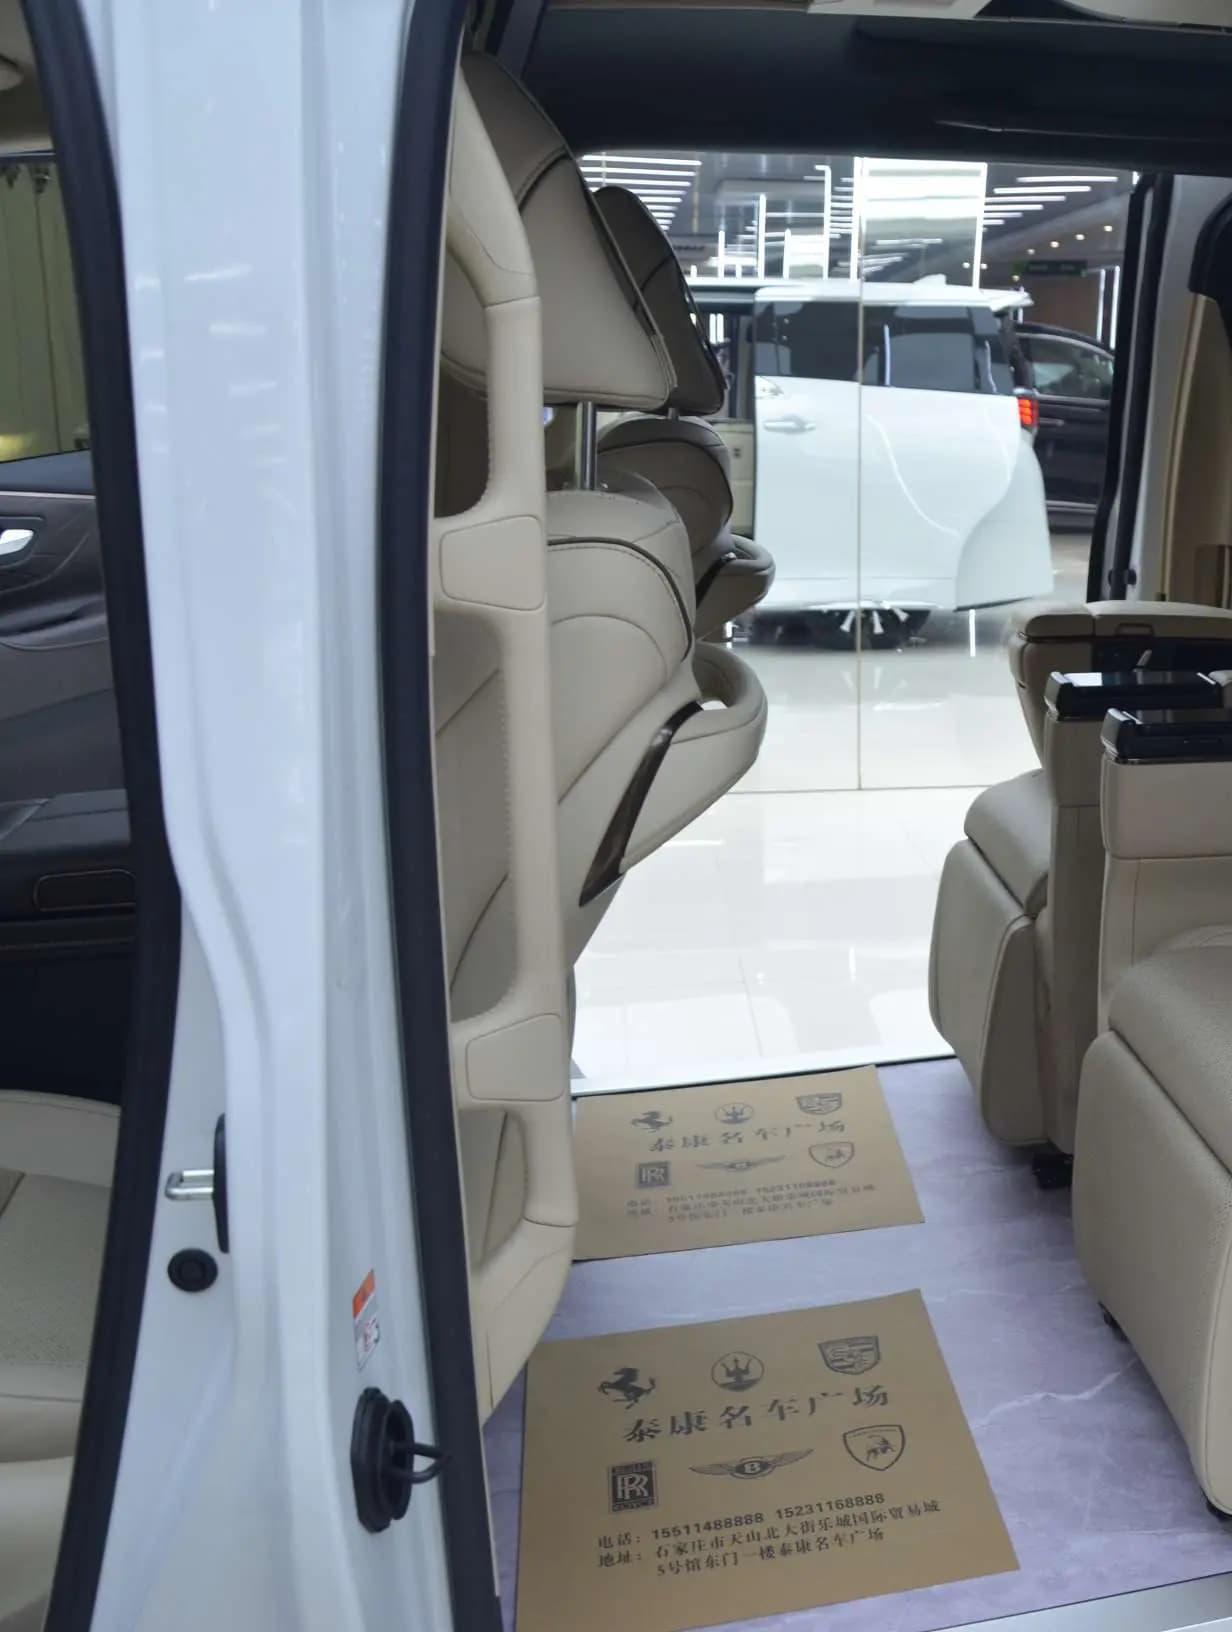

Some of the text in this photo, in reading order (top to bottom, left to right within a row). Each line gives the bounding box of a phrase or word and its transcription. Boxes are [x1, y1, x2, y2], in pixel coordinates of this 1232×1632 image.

[624, 1384, 888, 1442] 泰康名车广场
[652, 1512, 764, 1539] 15511488888
[775, 1492, 885, 1520] 15231168888
